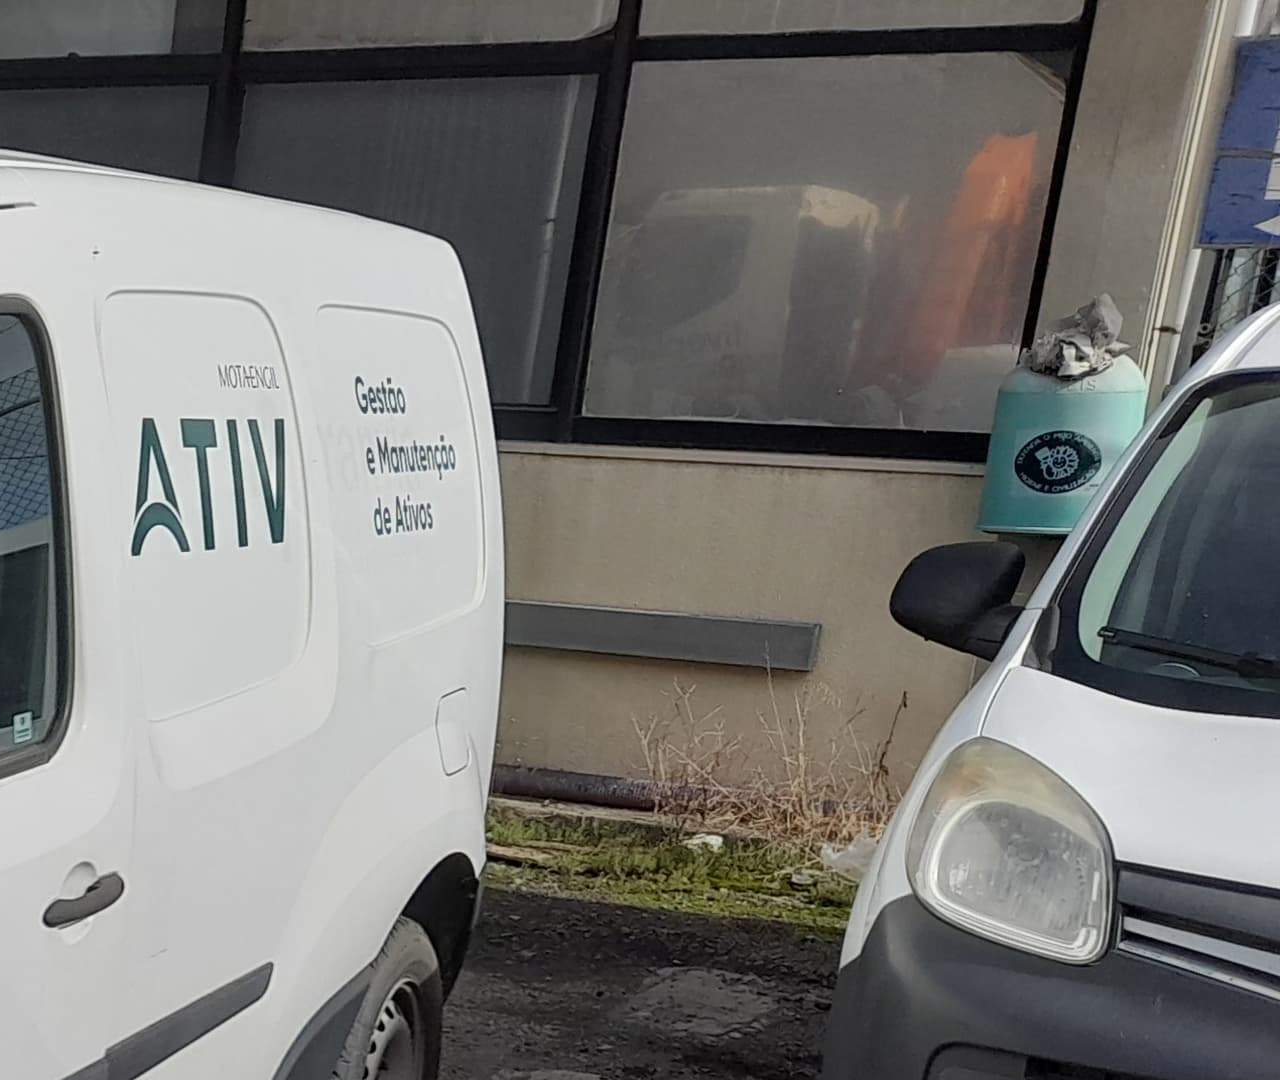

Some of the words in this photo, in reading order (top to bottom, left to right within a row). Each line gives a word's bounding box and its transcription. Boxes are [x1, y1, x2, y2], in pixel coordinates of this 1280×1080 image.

[354, 375, 406, 415] Gestão
[366, 446, 376, 475] e
[376, 435, 456, 480] Manutenção
[130, 417, 286, 557] ATIV
[373, 497, 392, 536] de
[395, 493, 433, 534] Ativos
